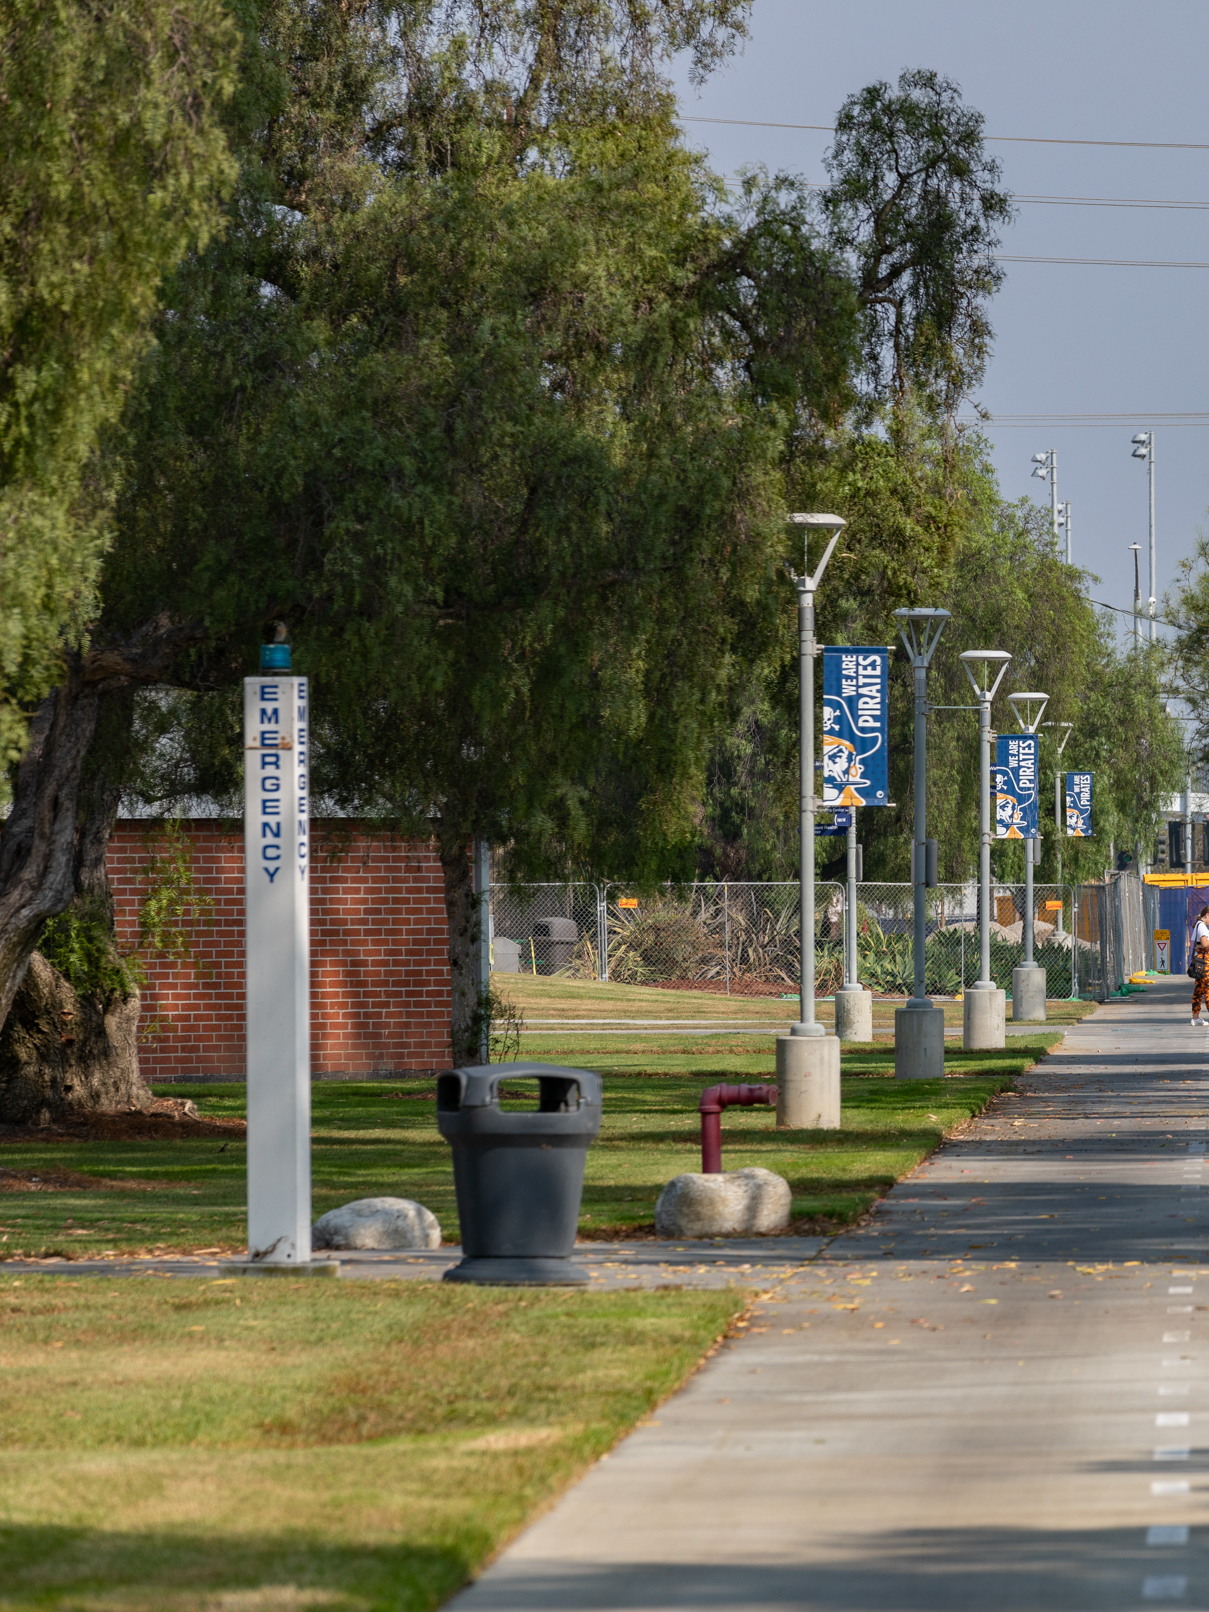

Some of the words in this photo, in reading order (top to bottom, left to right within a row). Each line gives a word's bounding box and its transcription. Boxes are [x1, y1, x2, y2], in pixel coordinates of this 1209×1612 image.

[842, 654, 857, 677] ARE
[842, 679, 857, 697] WE
[858, 655, 882, 727] PIRATES
[1009, 740, 1019, 755] ARE
[1009, 755, 1019, 768] WE
[1019, 740, 1035, 788] PIRATES
[259, 684, 281, 884] EMERGENCY
[297, 682, 307, 882] EMERGENCY
[1073, 785, 1081, 793] WE
[1080, 775, 1091, 805] PIRATES
